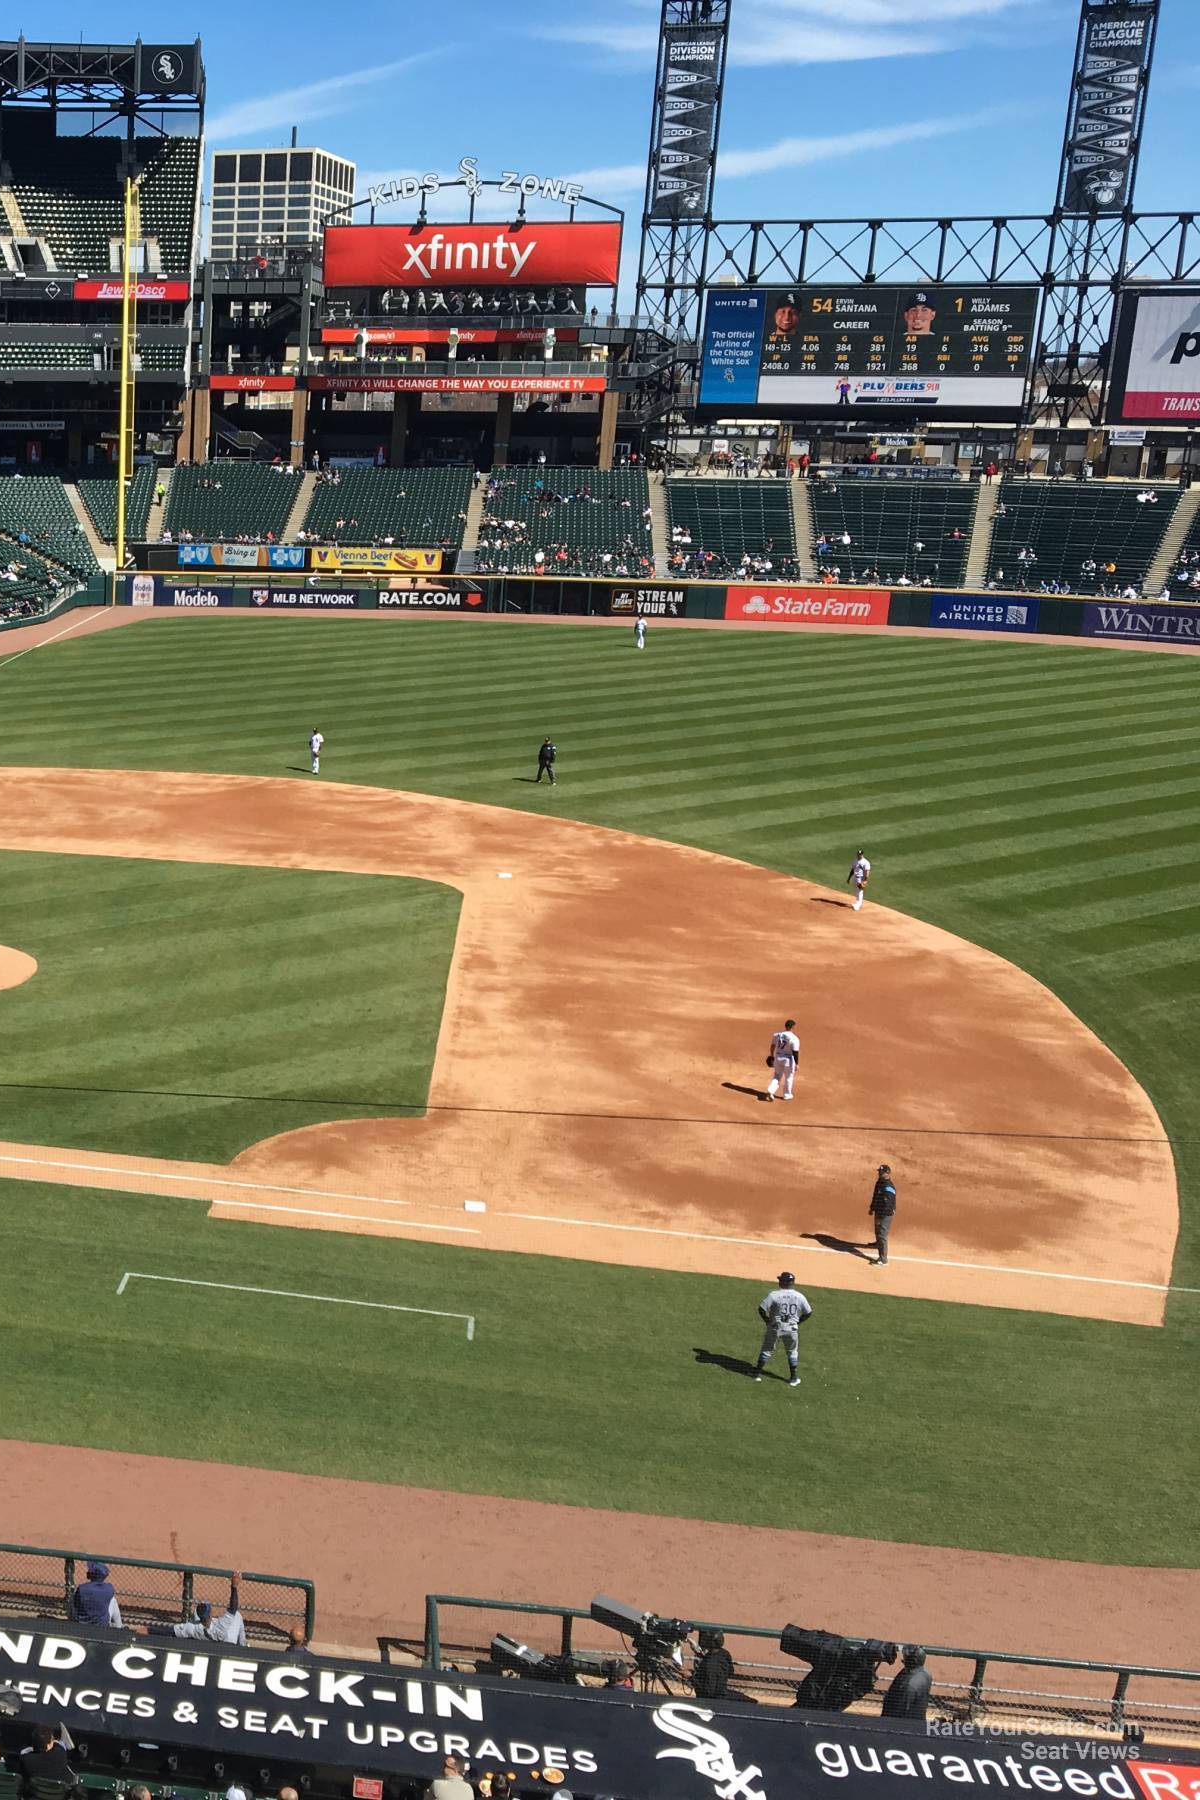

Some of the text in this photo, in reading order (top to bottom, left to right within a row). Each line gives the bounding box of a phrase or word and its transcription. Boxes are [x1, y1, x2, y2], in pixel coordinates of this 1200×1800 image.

[1092, 20, 1145, 31] AMERICAN
[1091, 28, 1144, 41] LEAGUE
[1089, 38, 1142, 48] CHAMPIONS
[670, 46, 715, 55] DIVISION
[669, 54, 714, 62] CHAMPIONS
[1102, 106, 1132, 114] 1917
[1098, 139, 1126, 147] 1901
[661, 155, 690, 163] 1993
[1075, 155, 1105, 163] 1900
[368, 171, 583, 207] KIDS ZONE
[402, 234, 537, 279] xfinity
[811, 298, 833, 312] 54
[955, 298, 964, 312] 1
[971, 304, 1010, 312] ADAMES
[727, 331, 754, 339] Official
[724, 349, 754, 358] Chicago
[870, 344, 885, 352] 381
[906, 344, 917, 352] 19
[969, 344, 989, 352] .316
[1004, 344, 1024, 352] .350
[866, 363, 886, 371] 1921
[898, 363, 918, 371] .368
[238, 377, 266, 389] xfinity
[326, 378, 584, 389] XFINITY X1 WILL CHANGE THE WAY YOU EXPERIENCE TV
[862, 382, 926, 394] PLUMBERS
[225, 547, 249, 559] Bring
[333, 550, 393, 561] Vienna Beef
[174, 590, 218, 607] Modelo
[273, 593, 354, 605] MLB NETWORK
[379, 592, 460, 606] RATE.COM
[637, 590, 683, 603] STREAM
[637, 602, 666, 615] YOUR
[953, 604, 1003, 614] UNITED
[939, 612, 1002, 622] AIRLINES
[111, 1646, 485, 1722] CHECK-IN
[173, 1701, 200, 1725] &
[218, 1707, 329, 1739] SEAT
[345, 1722, 598, 1774] UPGRADES
[814, 1741, 1136, 1800] guaranteed
